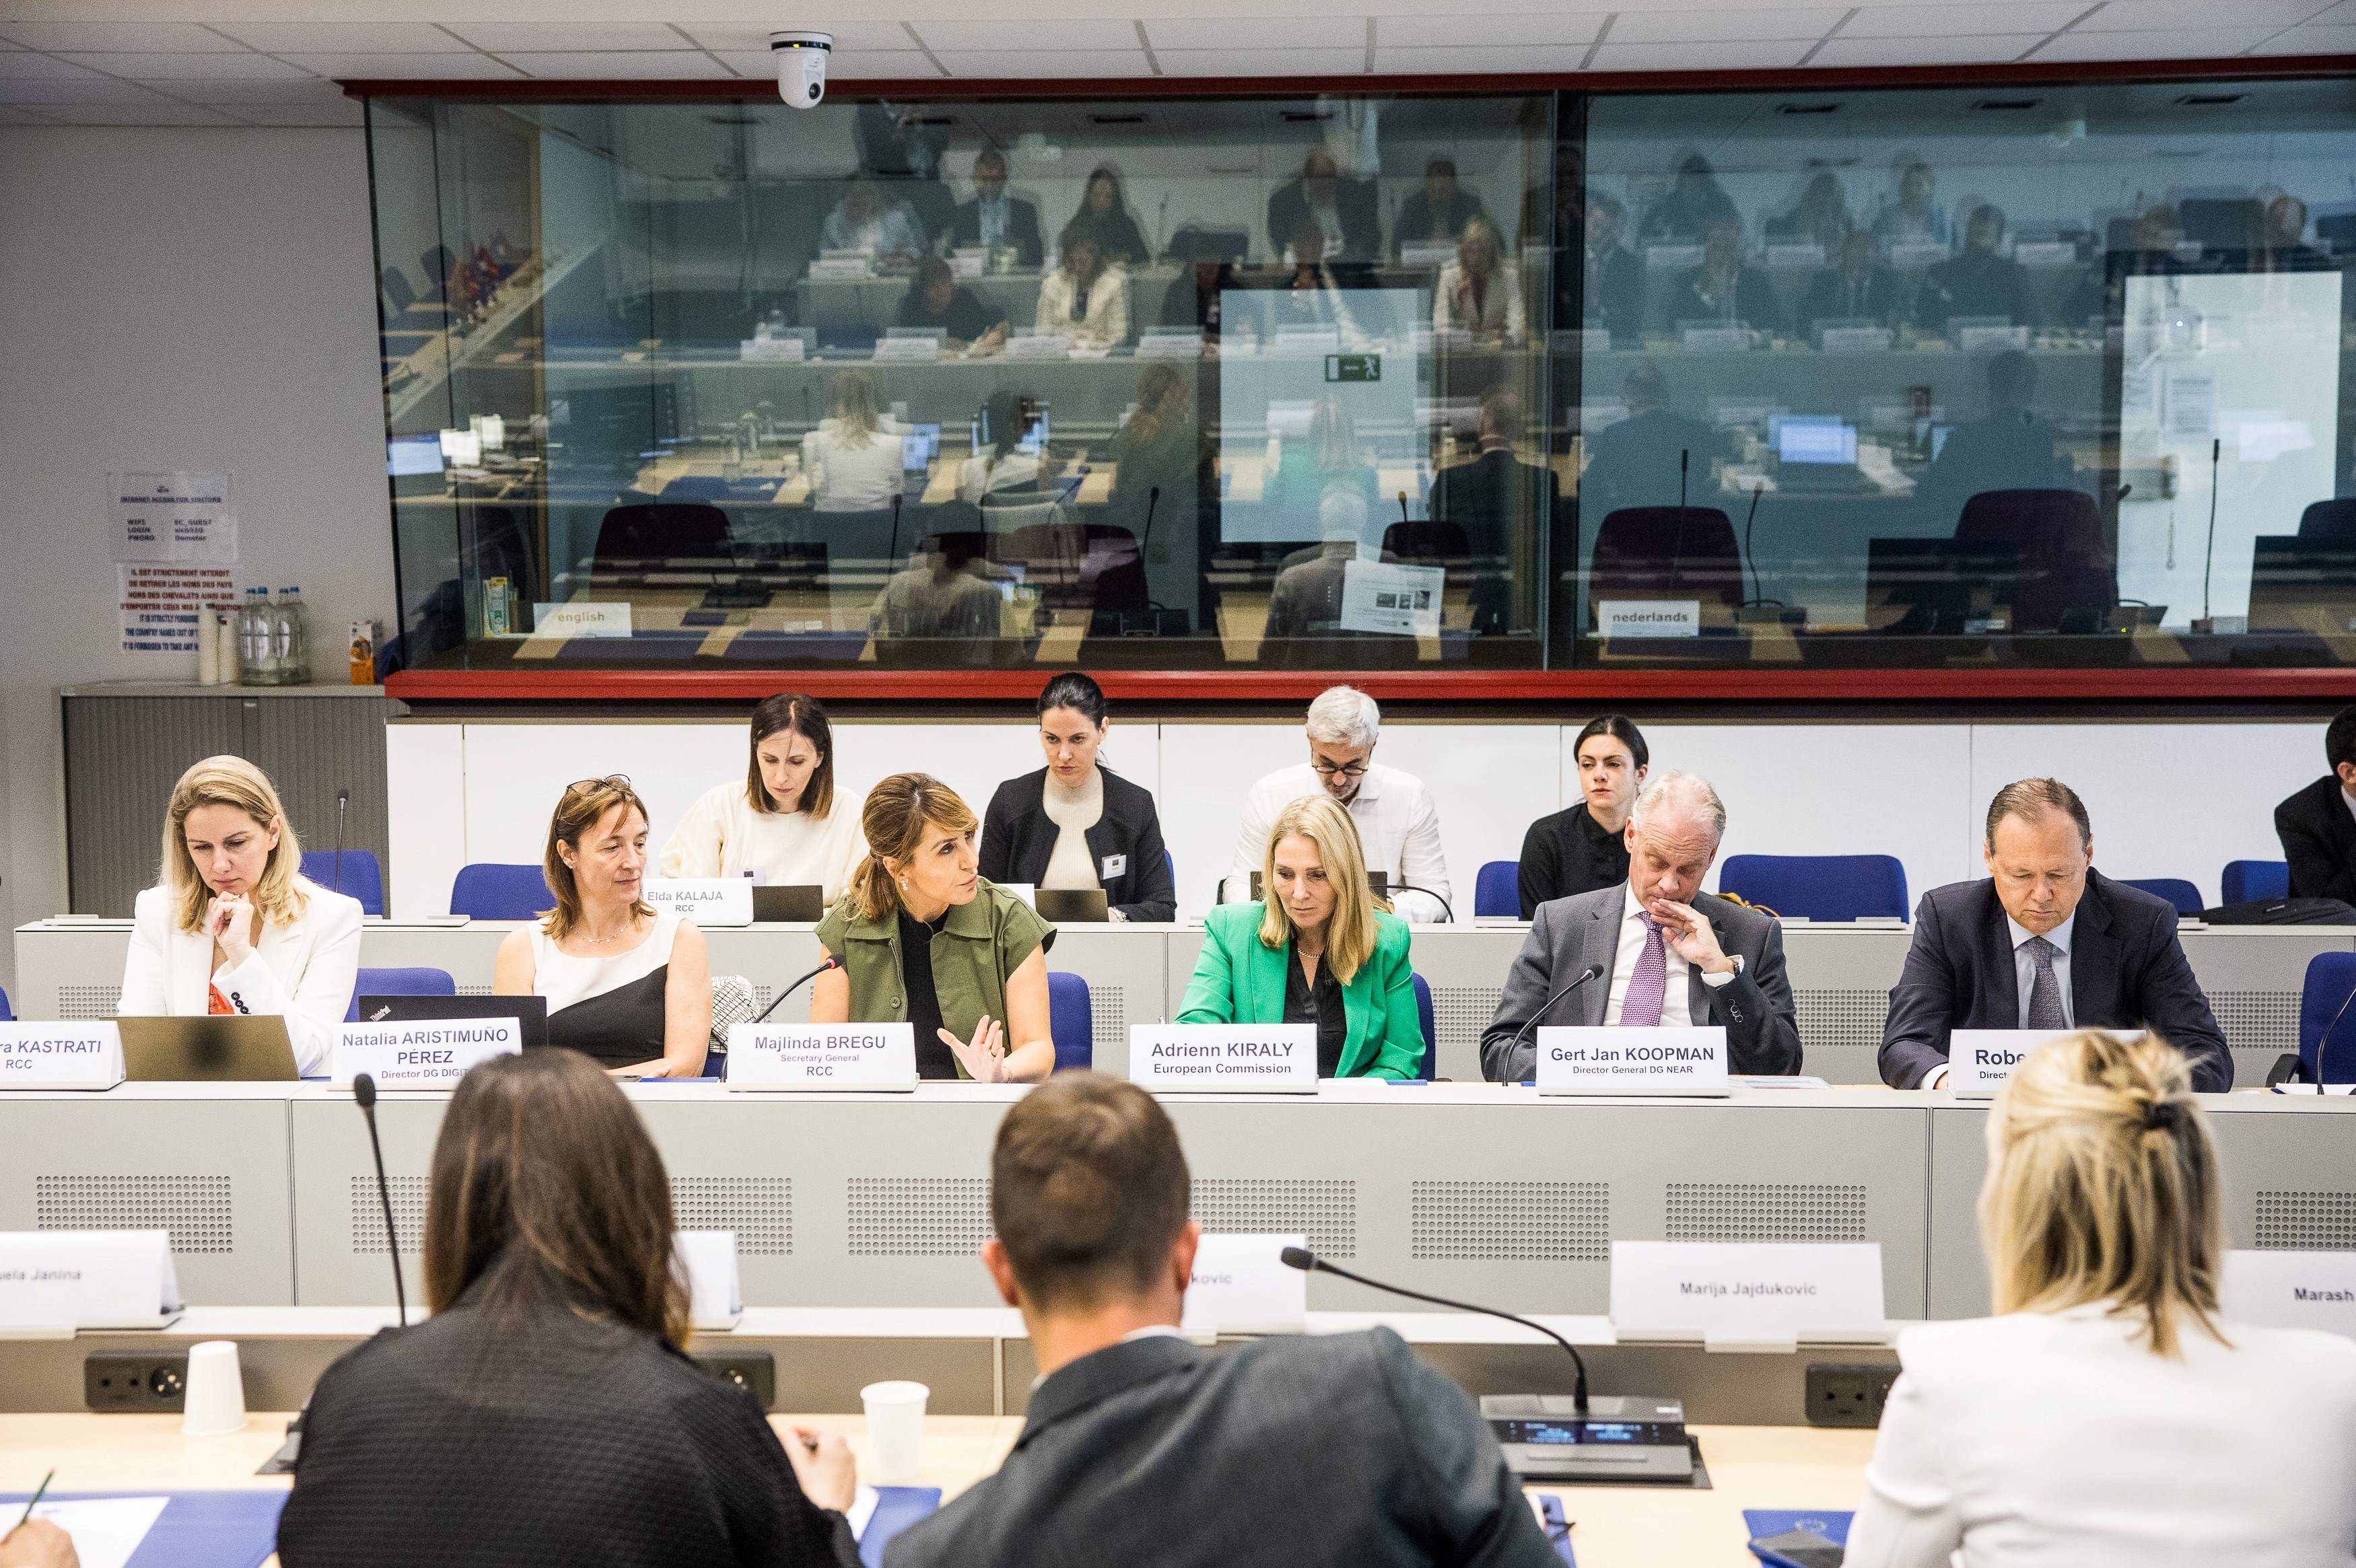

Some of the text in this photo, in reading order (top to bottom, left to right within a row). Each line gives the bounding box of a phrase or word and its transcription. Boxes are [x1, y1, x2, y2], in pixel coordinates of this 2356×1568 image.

[558, 612, 604, 624] english
[1613, 612, 1688, 622] nederlands
[648, 891, 723, 901] Elda KALAJA
[343, 1026, 508, 1046] Natalia ARISTIMUÑO
[18, 1040, 101, 1053] KASTRATI
[755, 1036, 885, 1052] Majlinda BREGU
[1151, 1043, 1293, 1057] Adrienn KIRALY
[398, 1048, 453, 1064] PÉREZ
[781, 1054, 860, 1063] Secretary General
[1551, 1047, 1714, 1061] Gert Jan KOOPMAN
[1975, 1049, 2026, 1065] Robe
[6, 1059, 32, 1069] RCC
[1154, 1063, 1291, 1075] European Commission
[382, 1070, 421, 1079] Director
[424, 1069, 438, 1077] DG
[806, 1066, 833, 1076] RCC
[1980, 1071, 2010, 1079] Direct
[30, 1268, 81, 1281] Janina
[1191, 1271, 1233, 1285] kovic
[1681, 1281, 1817, 1297] Marija Jajdukovic
[2294, 1287, 2355, 1302] Marash
